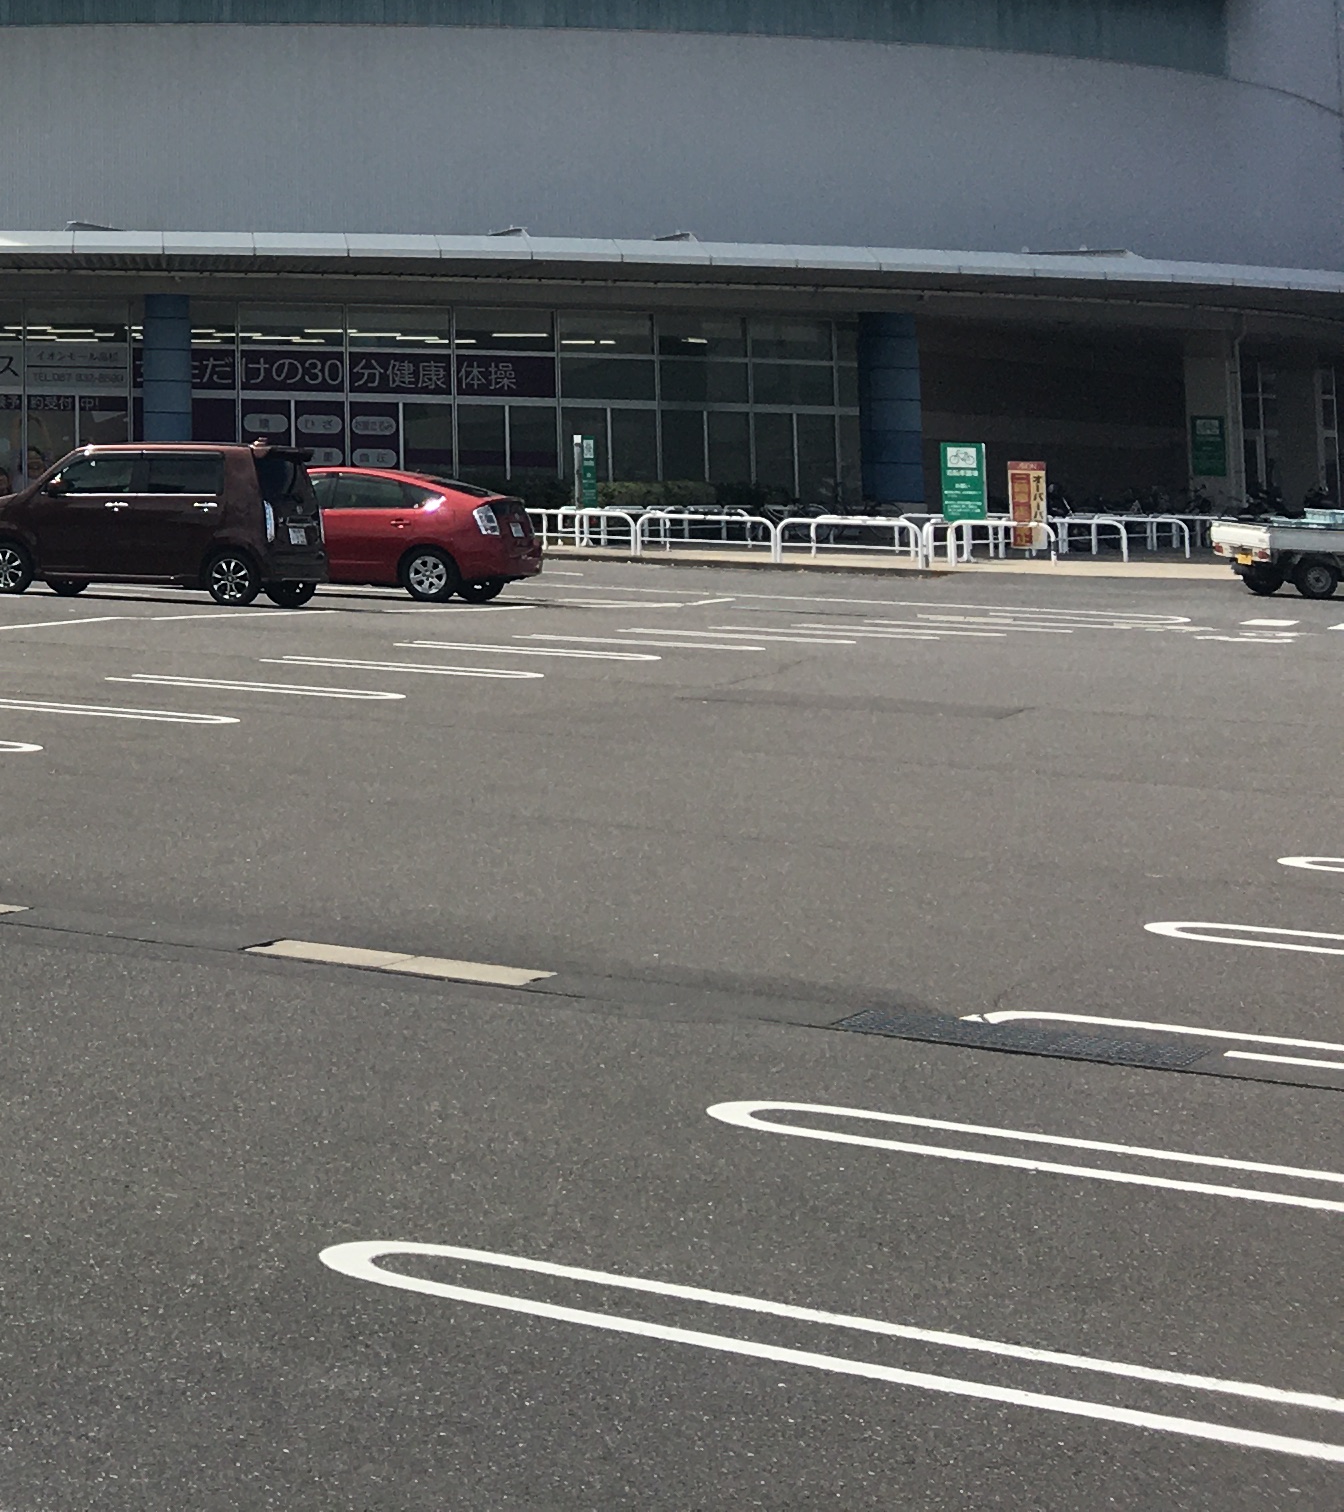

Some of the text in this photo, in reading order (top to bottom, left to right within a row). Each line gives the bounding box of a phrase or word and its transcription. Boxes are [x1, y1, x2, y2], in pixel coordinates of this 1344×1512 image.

[135, 356, 518, 390] だけの30分健康体操
